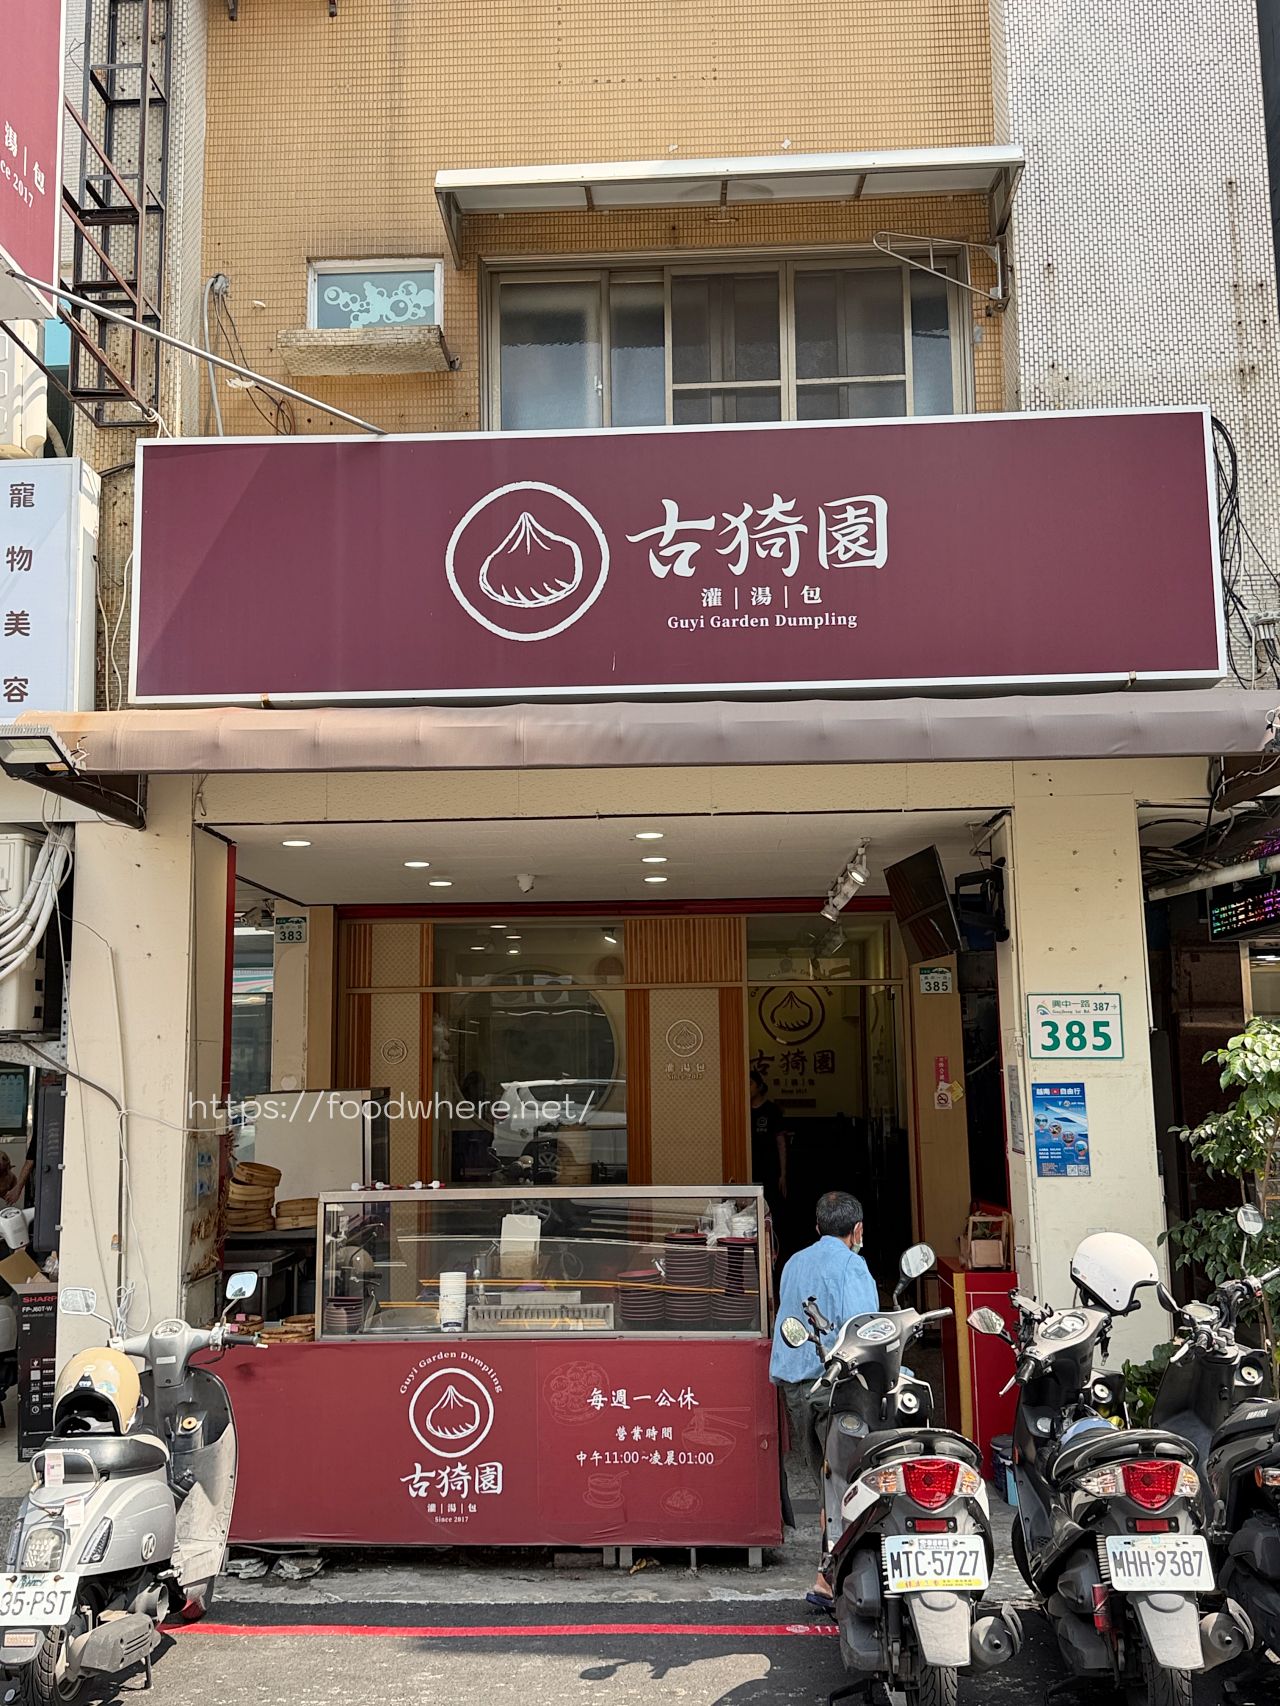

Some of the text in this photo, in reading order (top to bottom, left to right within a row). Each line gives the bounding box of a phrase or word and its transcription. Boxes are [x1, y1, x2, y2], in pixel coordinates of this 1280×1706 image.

[13, 173, 34, 208] 2017
[625, 493, 889, 578] 古猗園
[4, 482, 36, 703] 寵物美容
[667, 612, 858, 631] Guyi Garden Dumpling
[279, 930, 303, 941] 383
[925, 981, 949, 991] 385
[1093, 1002, 1109, 1011] 387
[1041, 1020, 1112, 1051] 385
[399, 1351, 503, 1394] Guyi Garden Dumpling
[586, 1386, 700, 1410] 每週一公休
[615, 1426, 673, 1442] 營業時間
[400, 1461, 503, 1499] 古猗園
